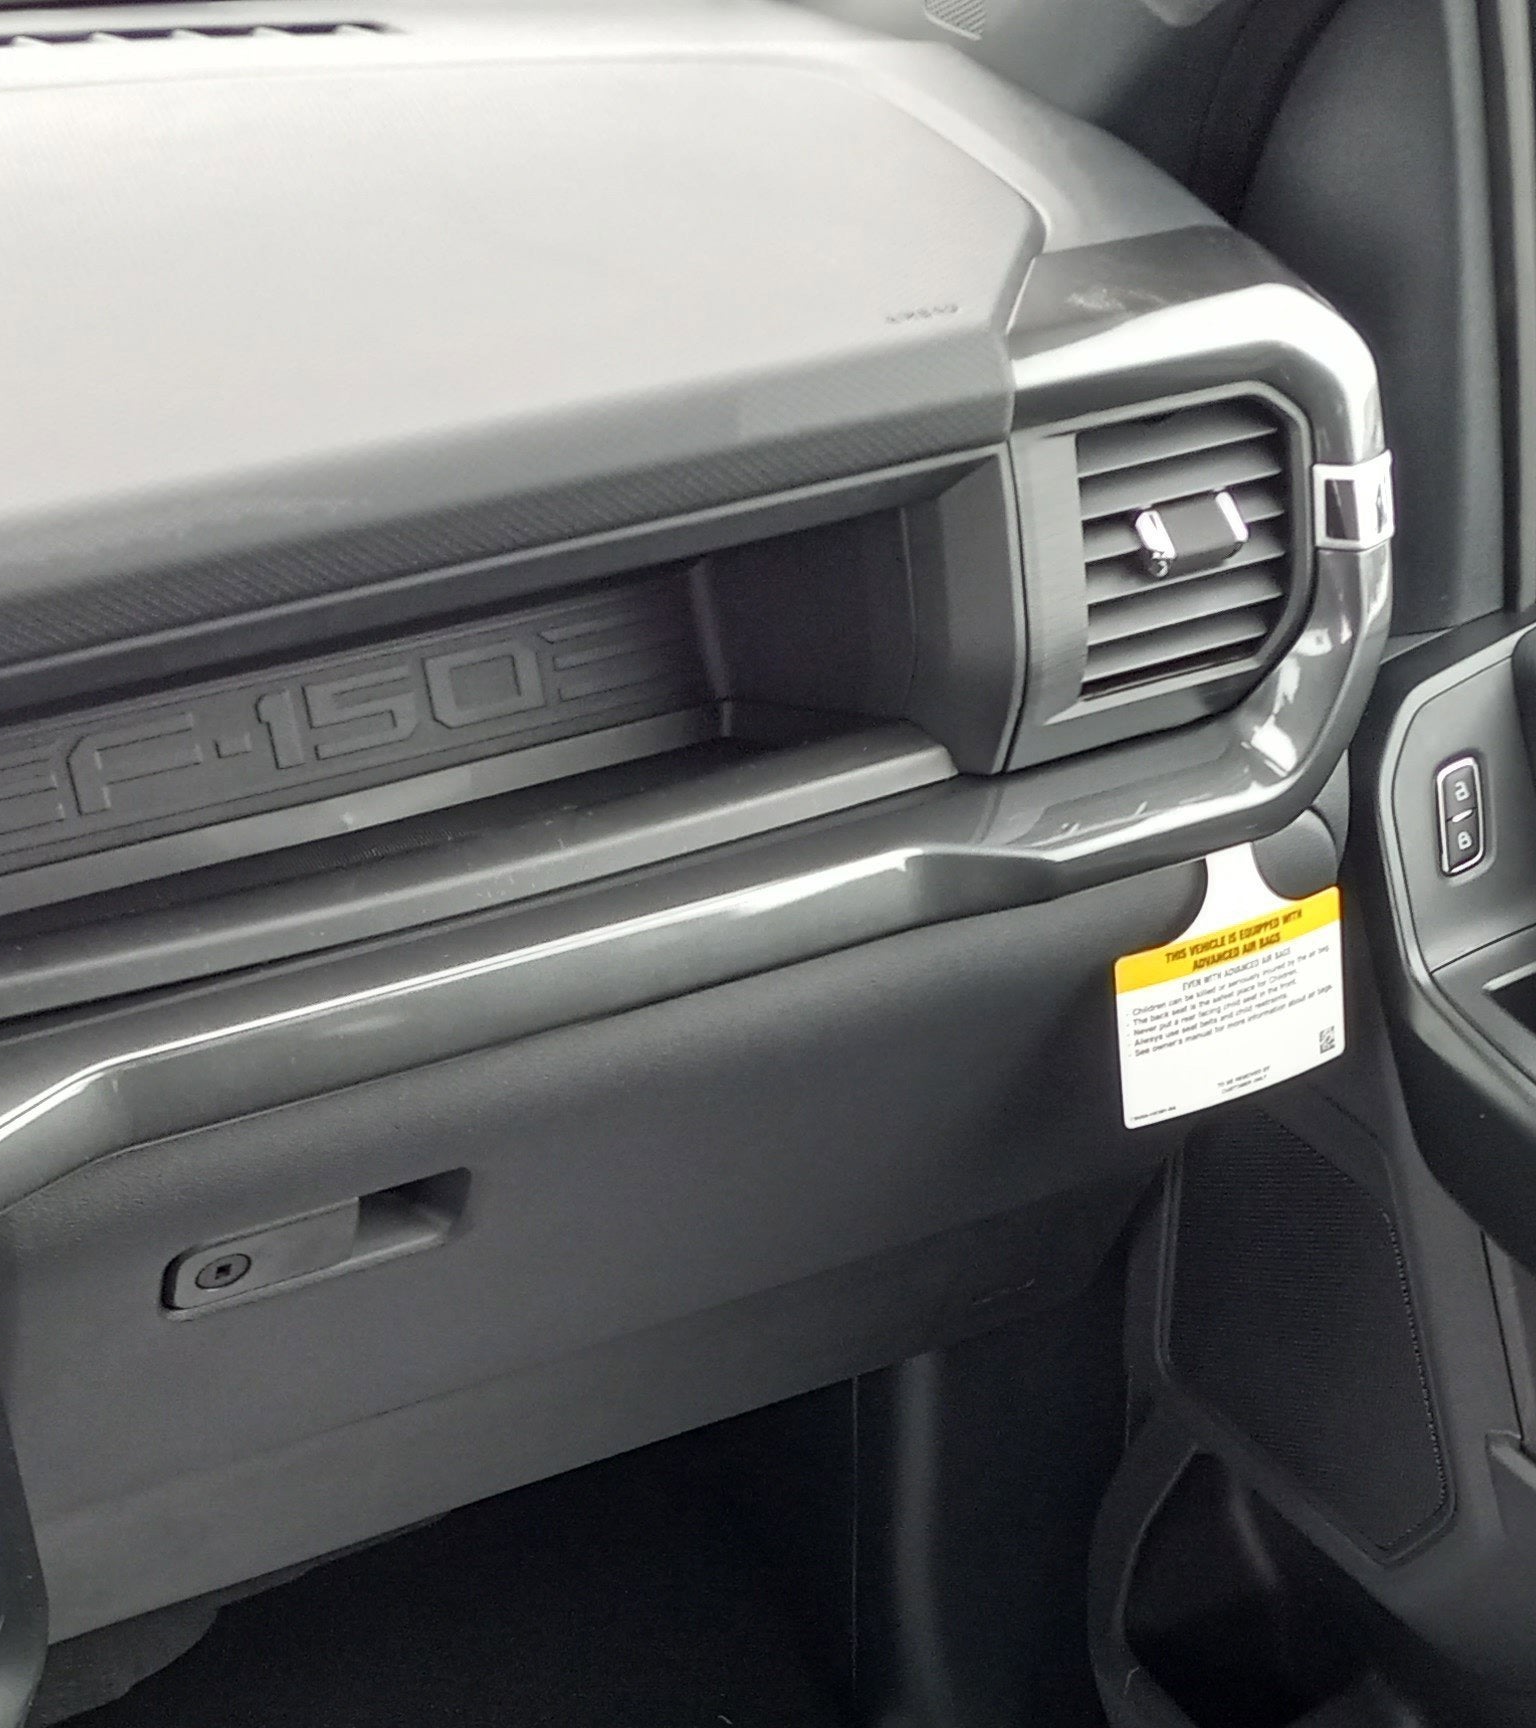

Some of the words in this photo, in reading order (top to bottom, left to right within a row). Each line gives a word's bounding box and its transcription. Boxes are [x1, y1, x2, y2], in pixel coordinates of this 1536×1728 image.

[66, 639, 548, 816] F-150
[1165, 948, 1186, 963] THIS
[1189, 935, 1225, 956] VEHICLE
[1228, 932, 1237, 944] IS
[1239, 917, 1279, 941] EQUIPPED
[1282, 909, 1302, 924] WITH
[1192, 946, 1239, 972] ADVANCED
[1242, 941, 1256, 955] AIR
[1259, 932, 1281, 949] BAGS
[1132, 1002, 1166, 1016] Children
[1168, 998, 1182, 1007] can
[1133, 1017, 1147, 1026] The
[1150, 1011, 1169, 1022] back
[1172, 1006, 1187, 1016] seat
[1134, 1025, 1157, 1036] Never
[1134, 1034, 1163, 1047] Always
[1135, 1048, 1150, 1057] See
[1152, 1039, 1183, 1053] owner's
